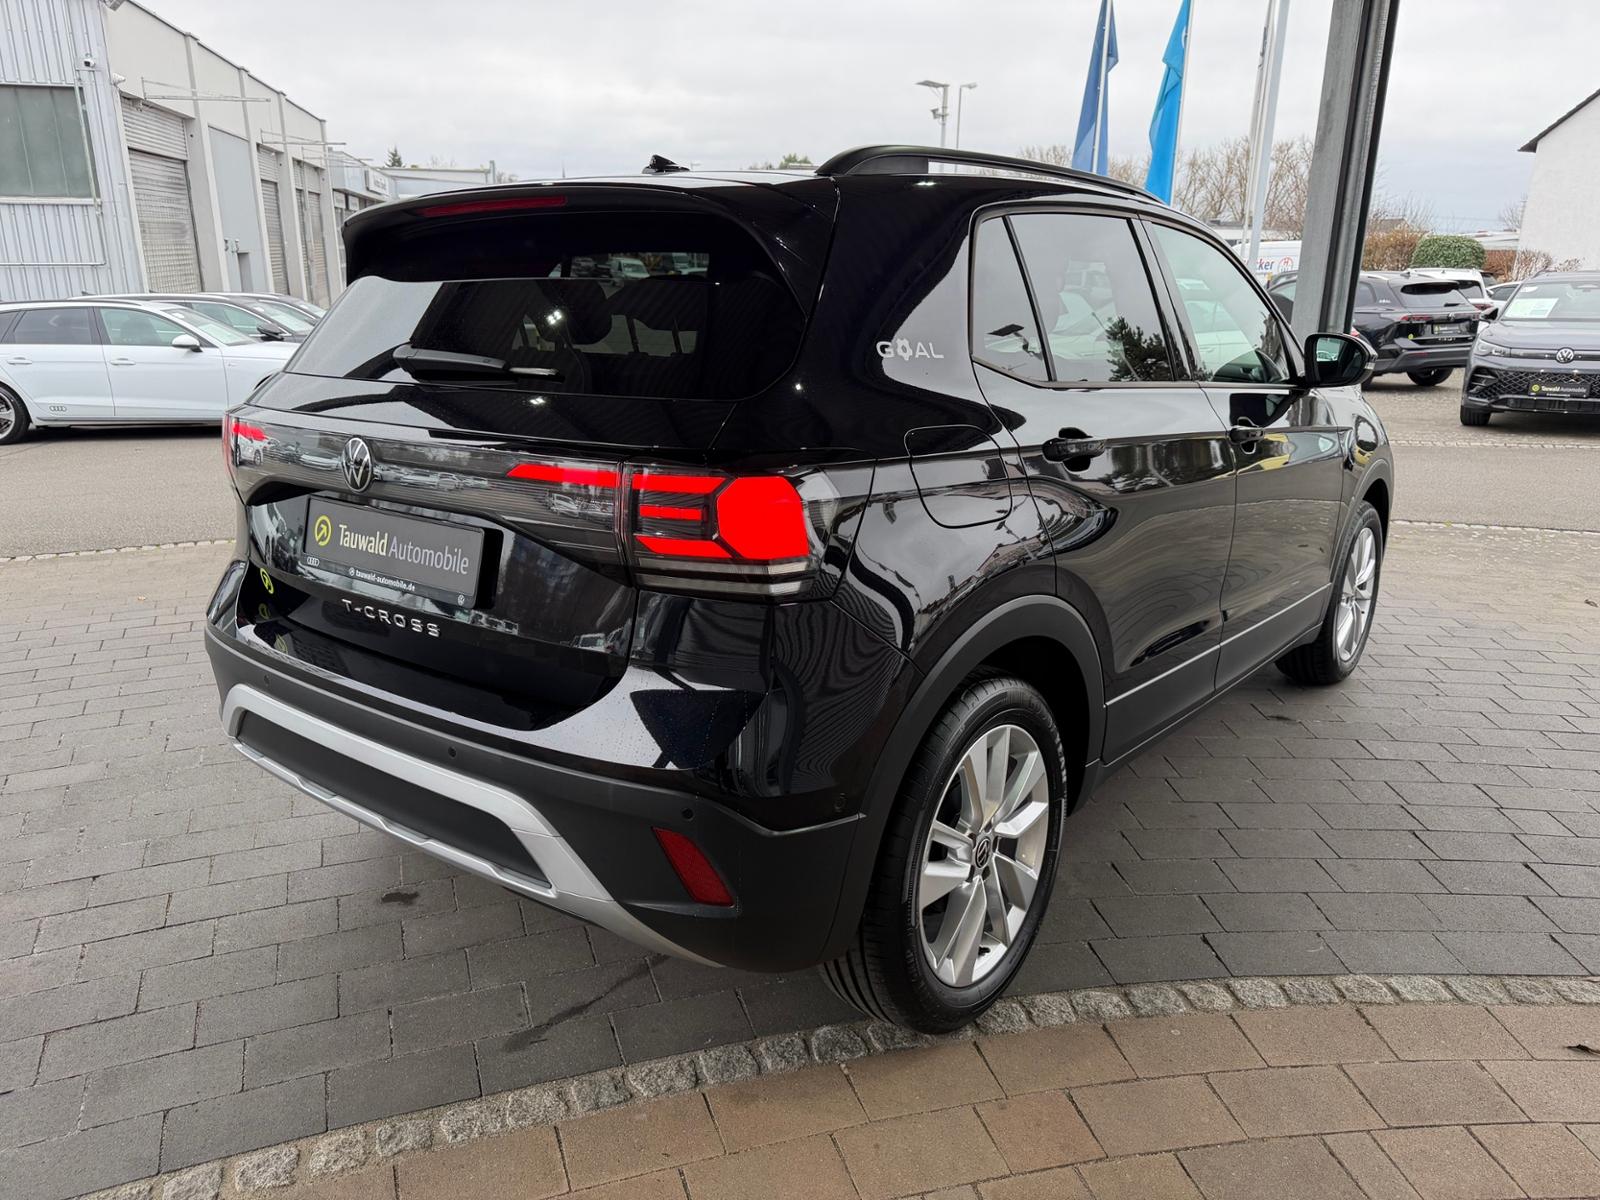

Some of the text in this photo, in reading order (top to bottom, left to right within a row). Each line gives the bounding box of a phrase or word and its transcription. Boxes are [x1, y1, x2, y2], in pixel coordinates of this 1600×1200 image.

[876, 338, 944, 361] GOAL
[338, 523, 468, 574] Tauwald Automobile
[356, 569, 415, 591] tauwald-automobile.de
[342, 599, 441, 637] T-CROSS
